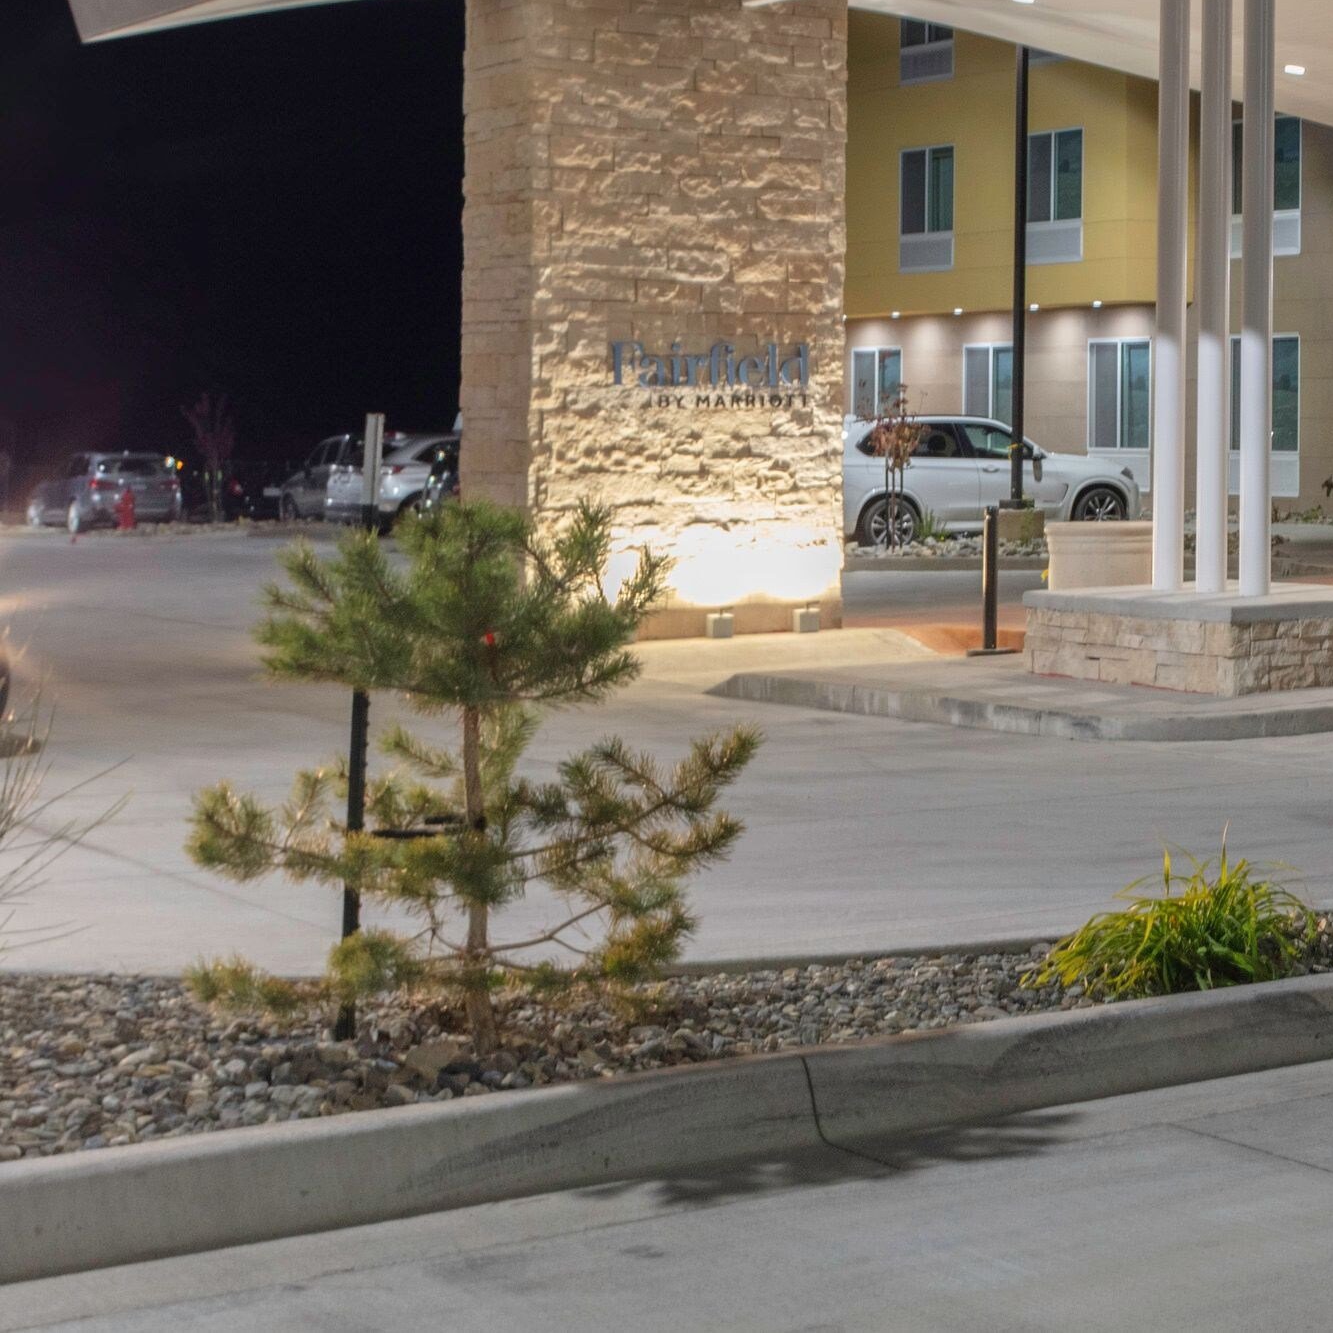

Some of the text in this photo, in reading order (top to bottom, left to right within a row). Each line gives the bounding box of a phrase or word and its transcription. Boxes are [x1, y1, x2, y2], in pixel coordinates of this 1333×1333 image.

[611, 340, 810, 387] Fairfield
[657, 394, 809, 408] BY MARRIOTT
